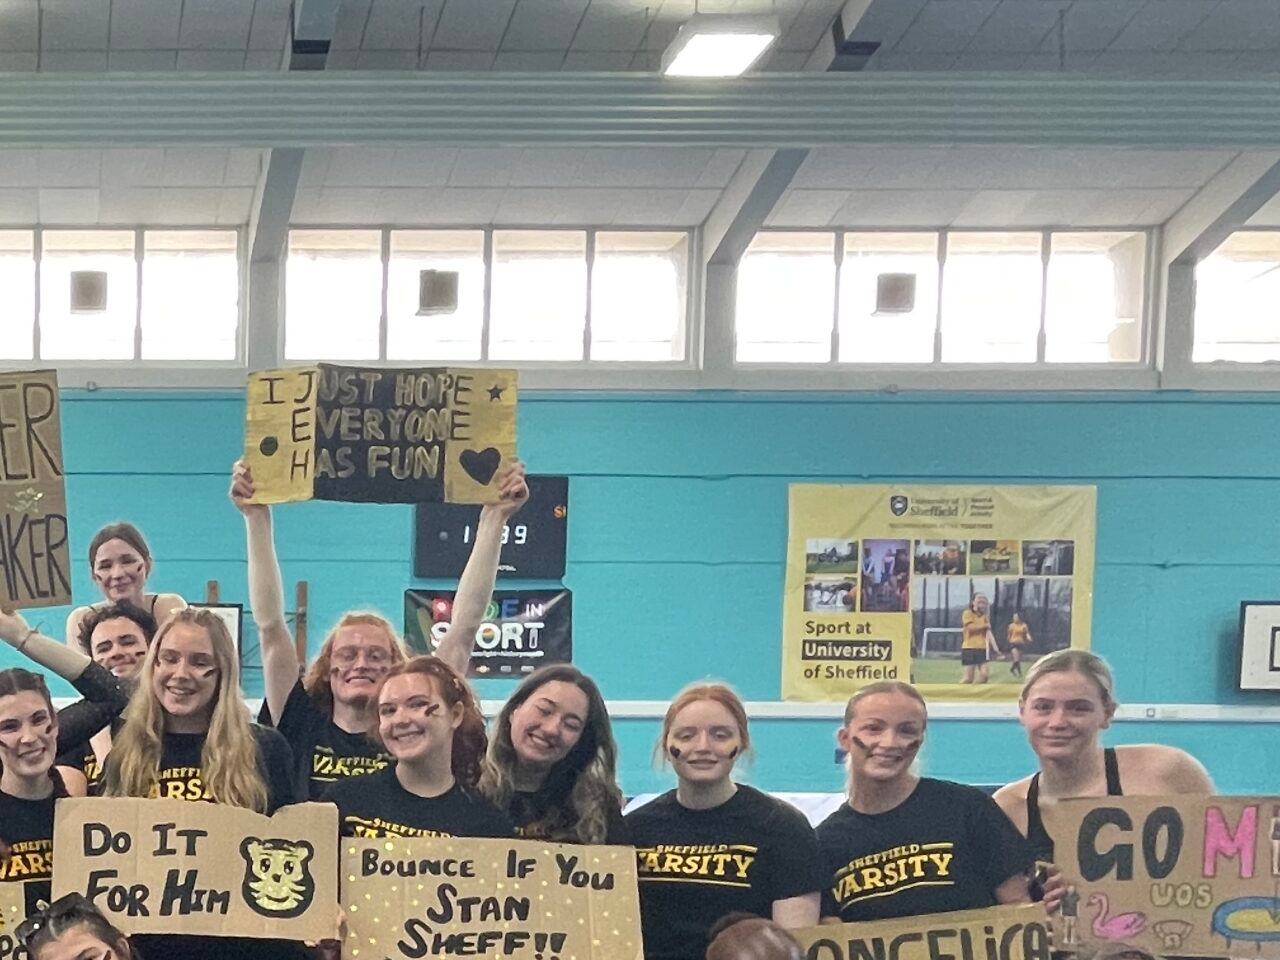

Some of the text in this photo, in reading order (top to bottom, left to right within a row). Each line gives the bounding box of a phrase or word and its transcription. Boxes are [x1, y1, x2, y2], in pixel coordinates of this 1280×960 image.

[259, 369, 473, 407] I JUST HOPE
[291, 407, 473, 443] EVERYONE
[290, 444, 440, 483] HAS FUN
[430, 622, 545, 650] SORT
[805, 620, 872, 636] Sport at
[805, 642, 891, 661] University
[803, 664, 898, 680] of Sheffield
[152, 822, 209, 857] IT
[656, 844, 729, 855] SHEFFIELD
[1076, 806, 1185, 882] GO
[506, 849, 537, 879] IF
[639, 852, 755, 878] ARSITY
[848, 843, 921, 872] SHEFFIELD
[85, 869, 231, 917] FOR HIM
[832, 853, 954, 903] VARSITY
[426, 882, 531, 923] STAN
